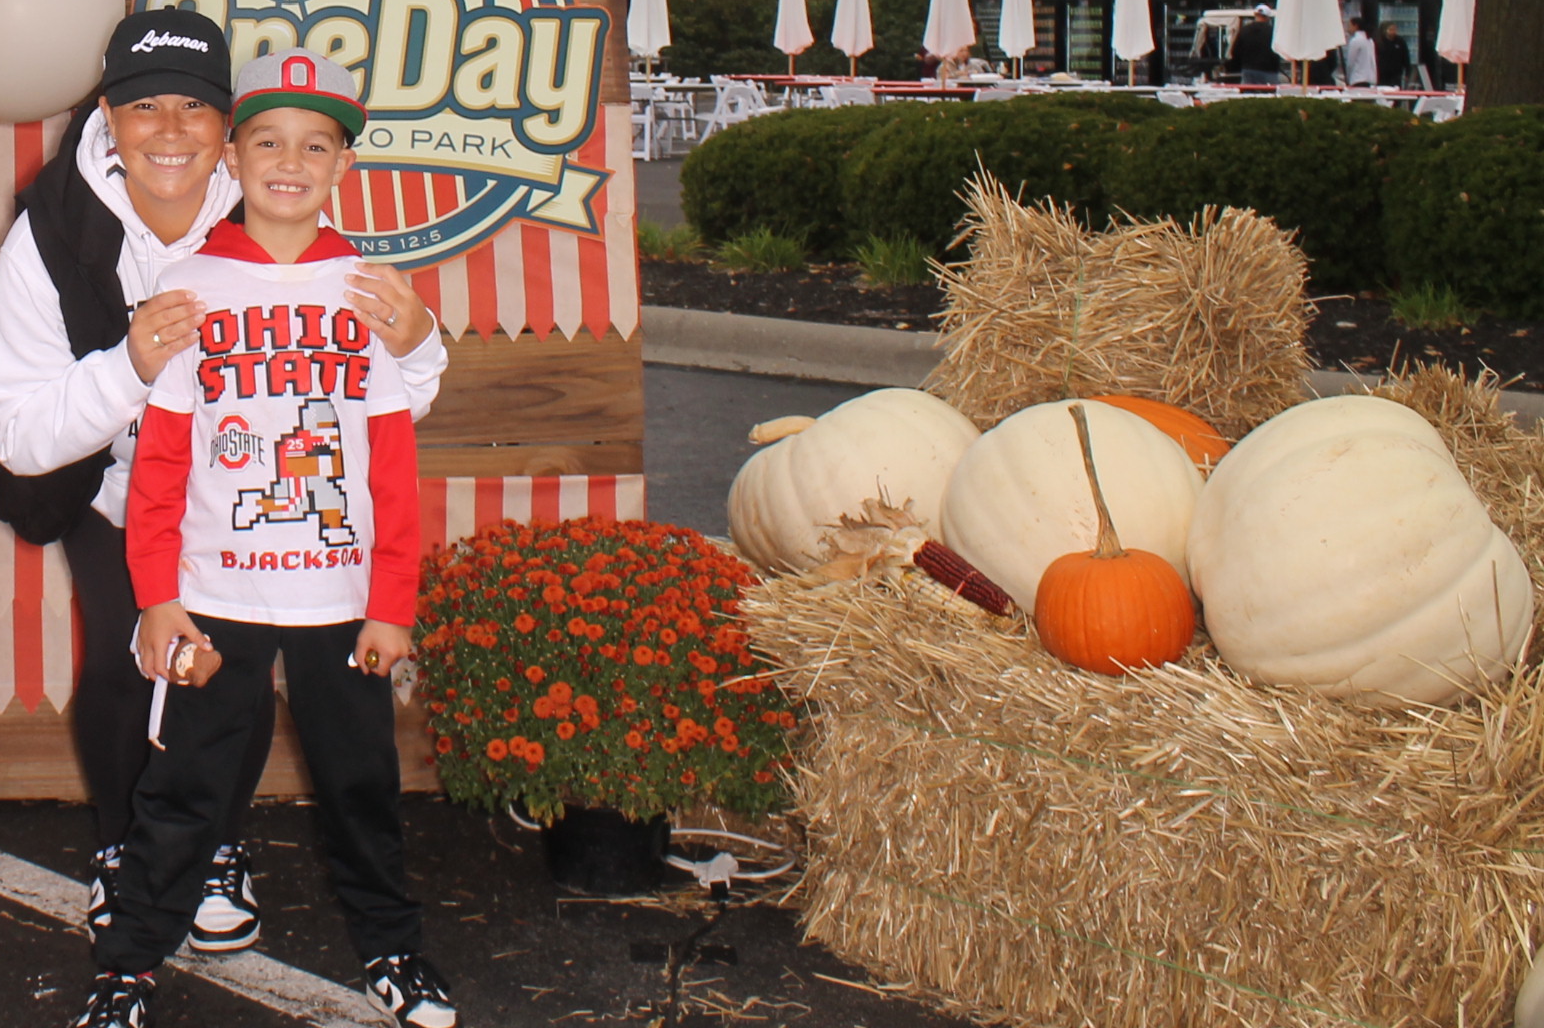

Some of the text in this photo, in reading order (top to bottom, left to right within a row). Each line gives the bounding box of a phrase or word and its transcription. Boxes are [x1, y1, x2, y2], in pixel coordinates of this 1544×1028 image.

[131, 29, 209, 53] Lebanon
[410, 129, 513, 159] PARK
[399, 229, 442, 250] 12:5
[198, 305, 370, 357] OHIO
[196, 350, 370, 404] STATE
[286, 438, 305, 450] 25
